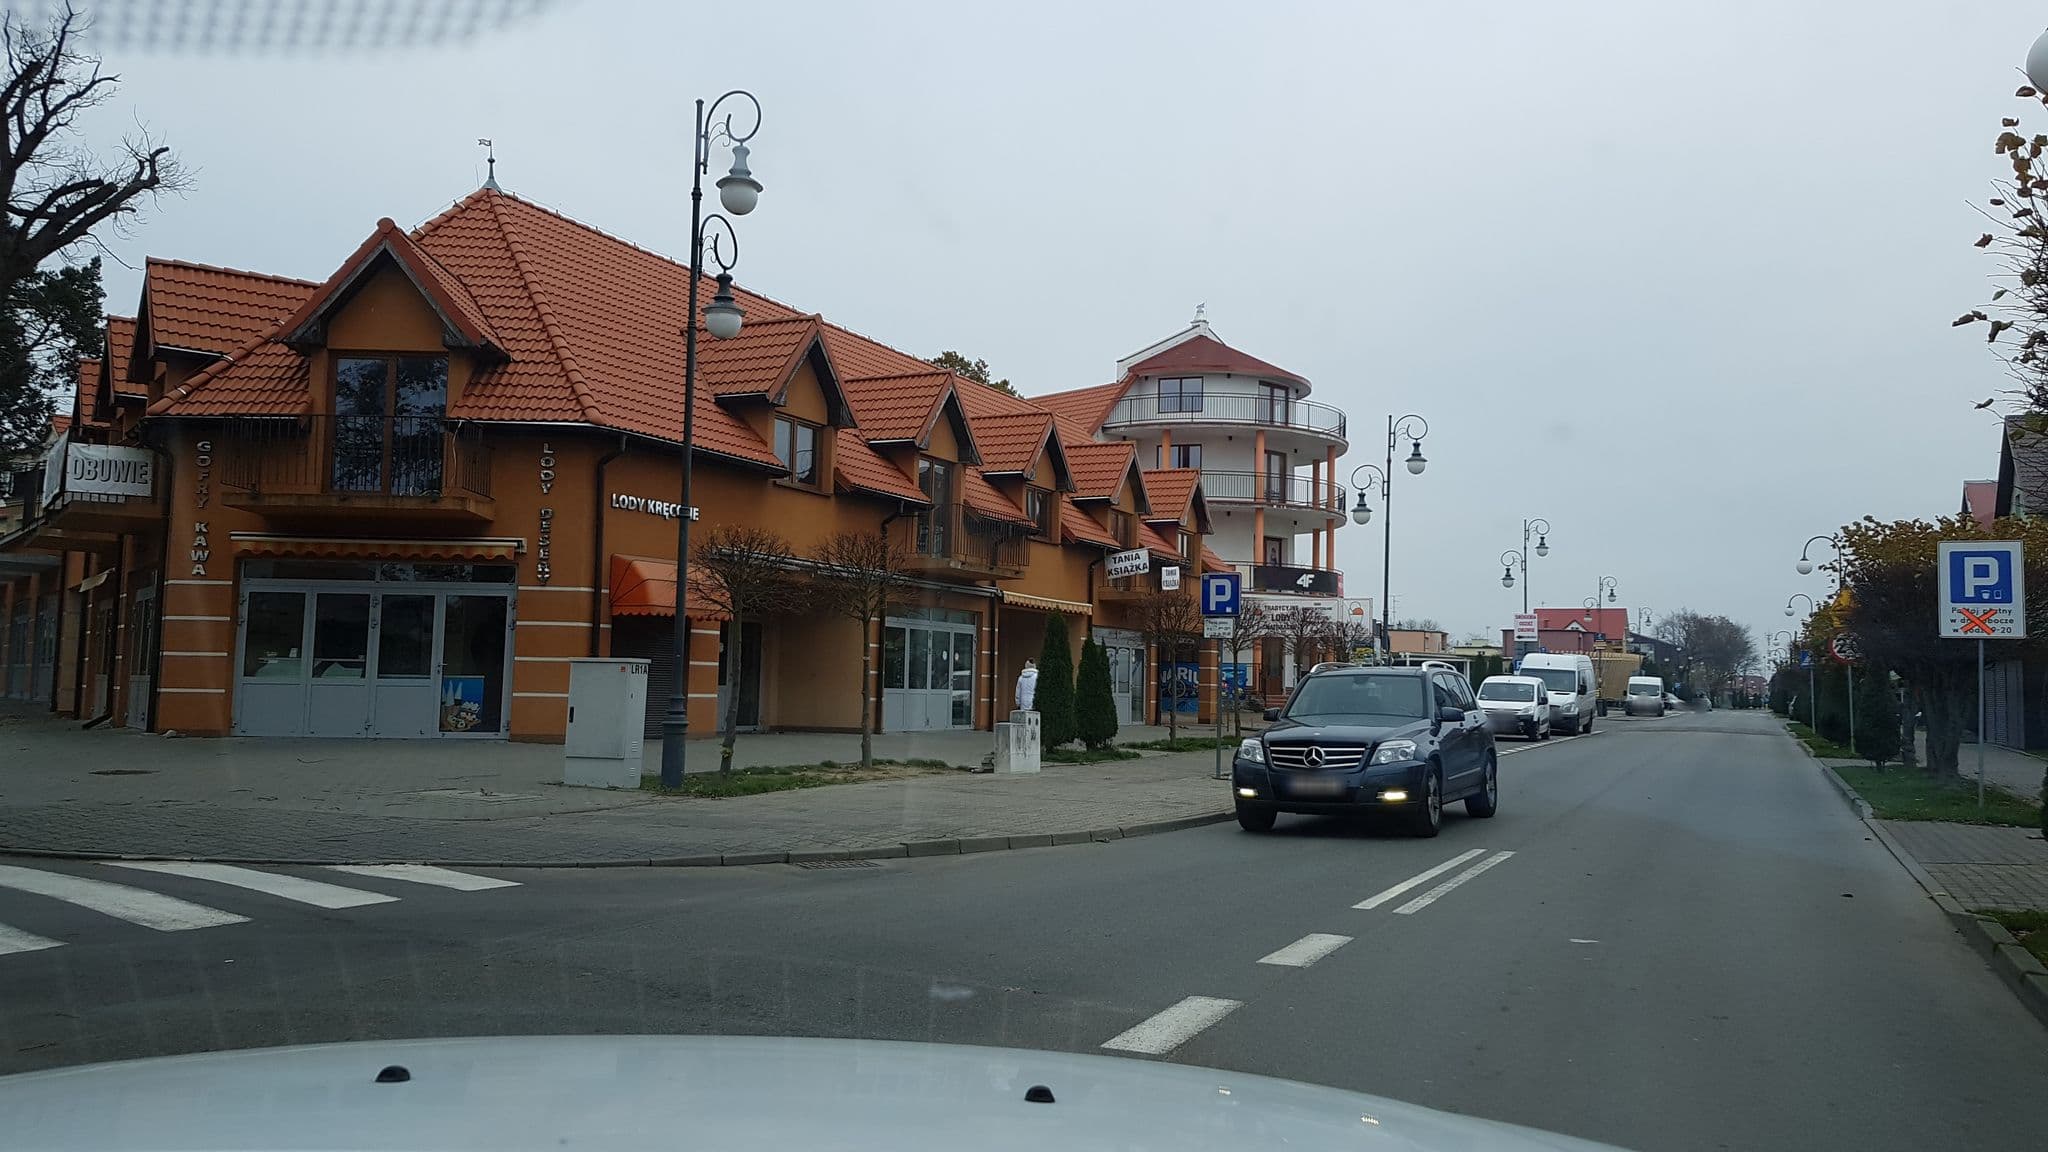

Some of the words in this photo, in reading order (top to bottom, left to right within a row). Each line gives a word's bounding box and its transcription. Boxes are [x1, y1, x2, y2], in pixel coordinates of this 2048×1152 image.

[72, 456, 149, 485] OBUWIE
[540, 443, 556, 494] LODY
[612, 493, 645, 512] LODY
[647, 499, 700, 520] KRĘCE
[190, 522, 210, 575] KAWA
[1111, 552, 1141, 565] TANIA
[1107, 562, 1148, 577] KSIĄŻKA
[1296, 573, 1315, 588] 4F
[1963, 556, 2000, 598] P
[1210, 578, 1232, 611] P
